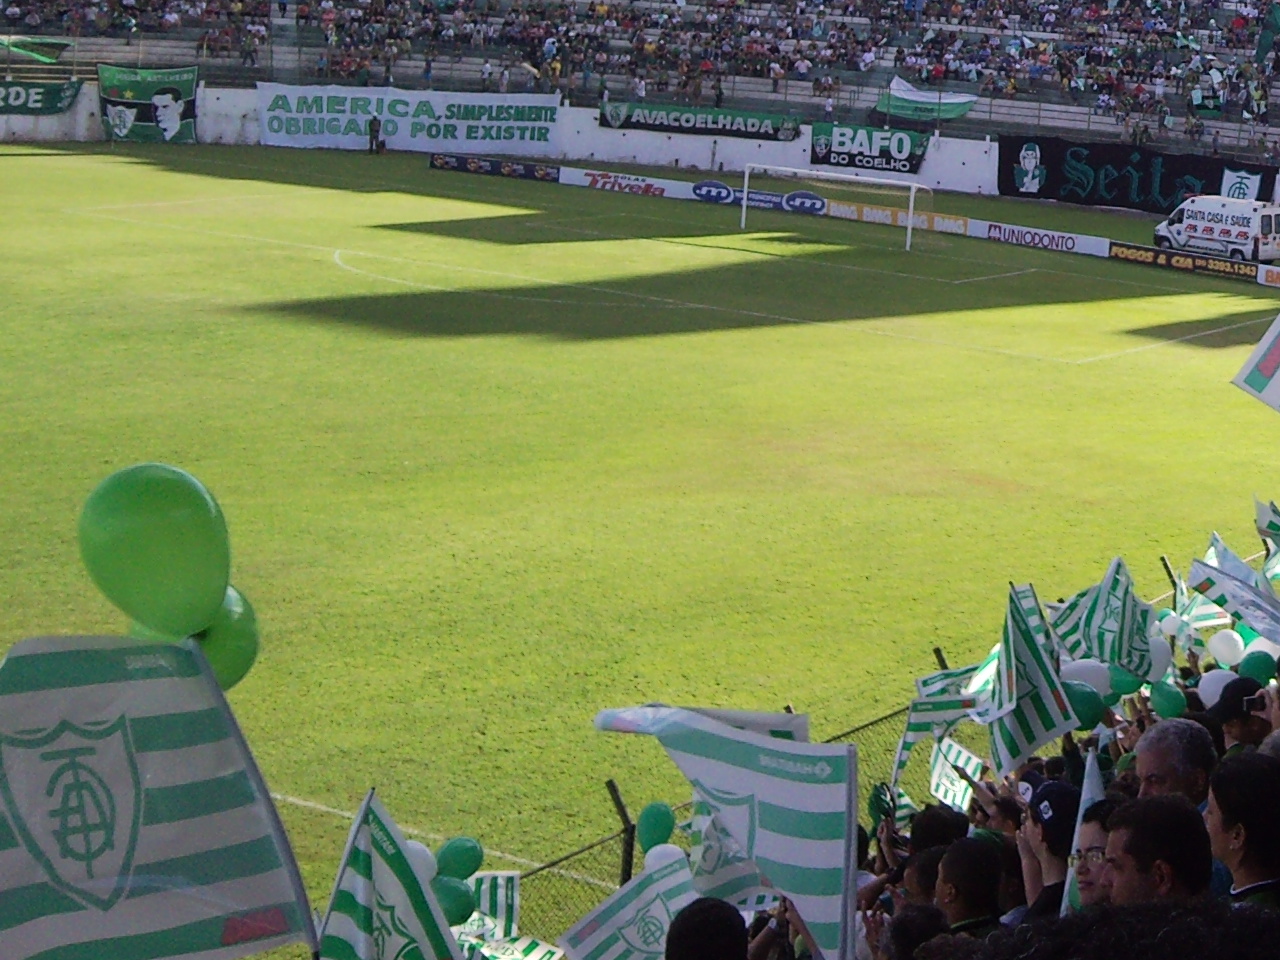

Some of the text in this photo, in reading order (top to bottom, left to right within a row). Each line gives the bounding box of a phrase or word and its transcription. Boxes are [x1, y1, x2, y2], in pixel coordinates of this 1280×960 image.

[267, 115, 550, 142] OBRIGAO POR EXISTIR
[631, 108, 774, 134] AVACOELHADA
[831, 127, 911, 160] BAFO
[830, 153, 910, 171] DO COELHO
[1185, 208, 1206, 221] SANTA
[1206, 211, 1224, 224] CASA
[1003, 228, 1076, 251] UNIODONTO
[1111, 245, 1155, 263] FOGOS
[1157, 254, 1167, 265] &
[1171, 256, 1193, 269] CIA
